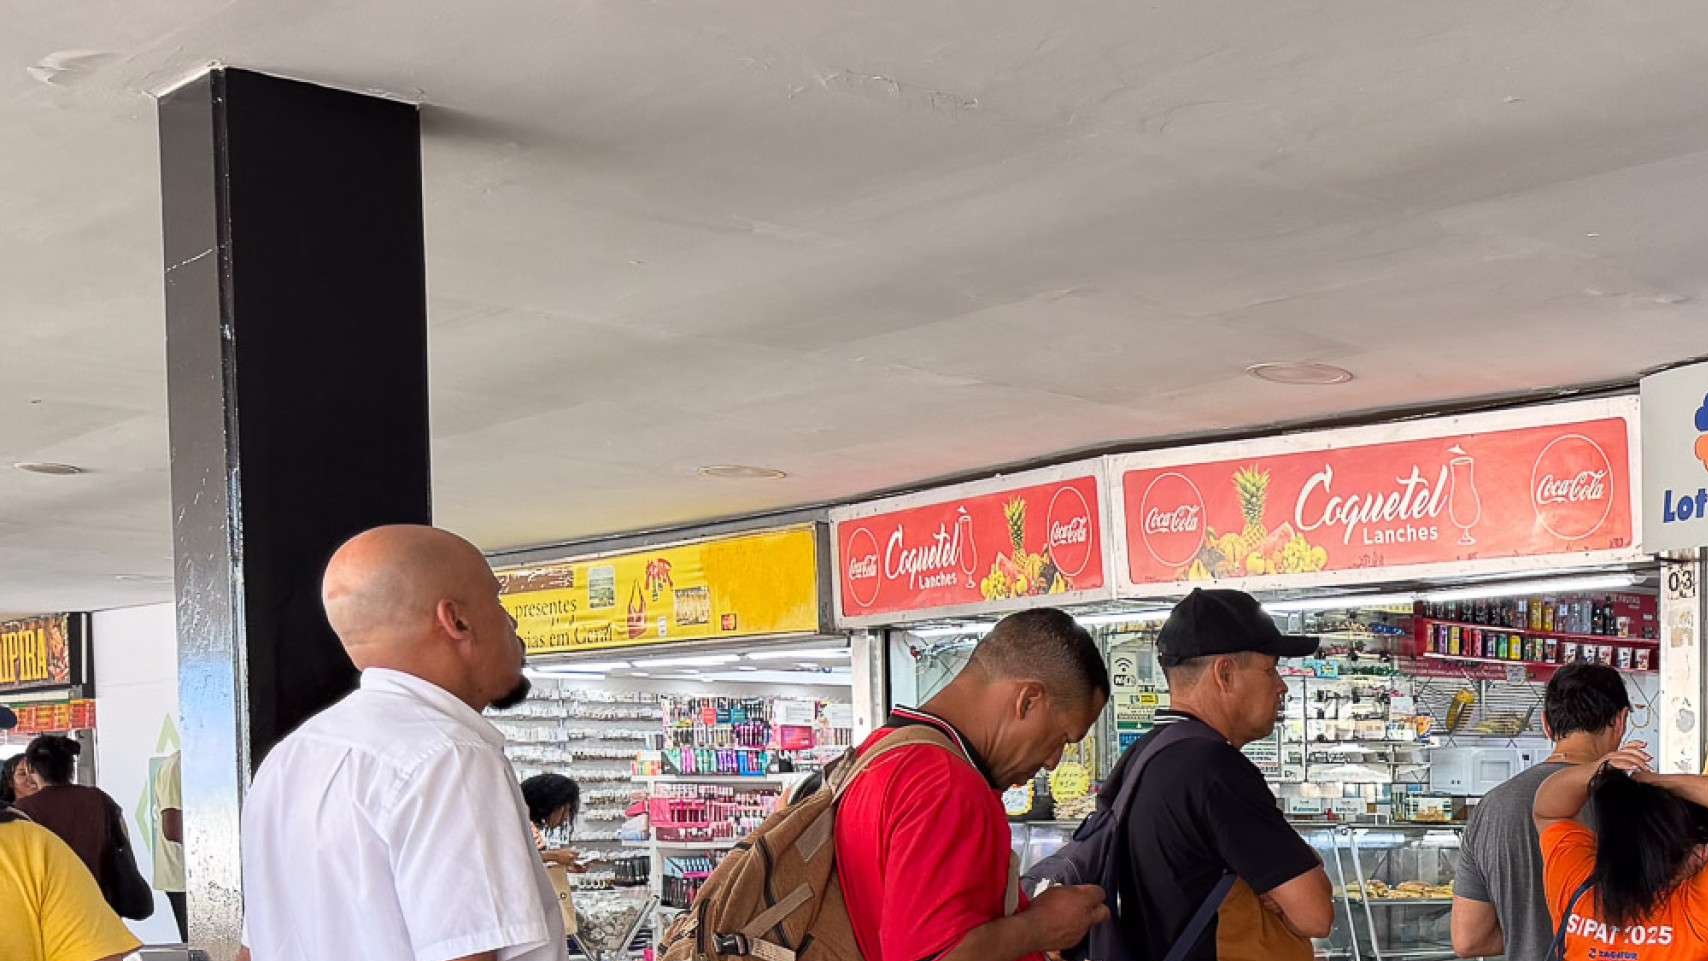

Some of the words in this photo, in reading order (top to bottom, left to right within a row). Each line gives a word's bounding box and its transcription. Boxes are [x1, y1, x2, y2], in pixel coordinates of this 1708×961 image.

[1295, 464, 1447, 544] Coquetel
[1363, 526, 1438, 545] Lanches
[885, 522, 960, 590] Coquetel
[919, 571, 957, 589] Lanches
[1669, 570, 1692, 591] 03
[514, 598, 577, 619] presentes
[549, 632, 569, 646] em
